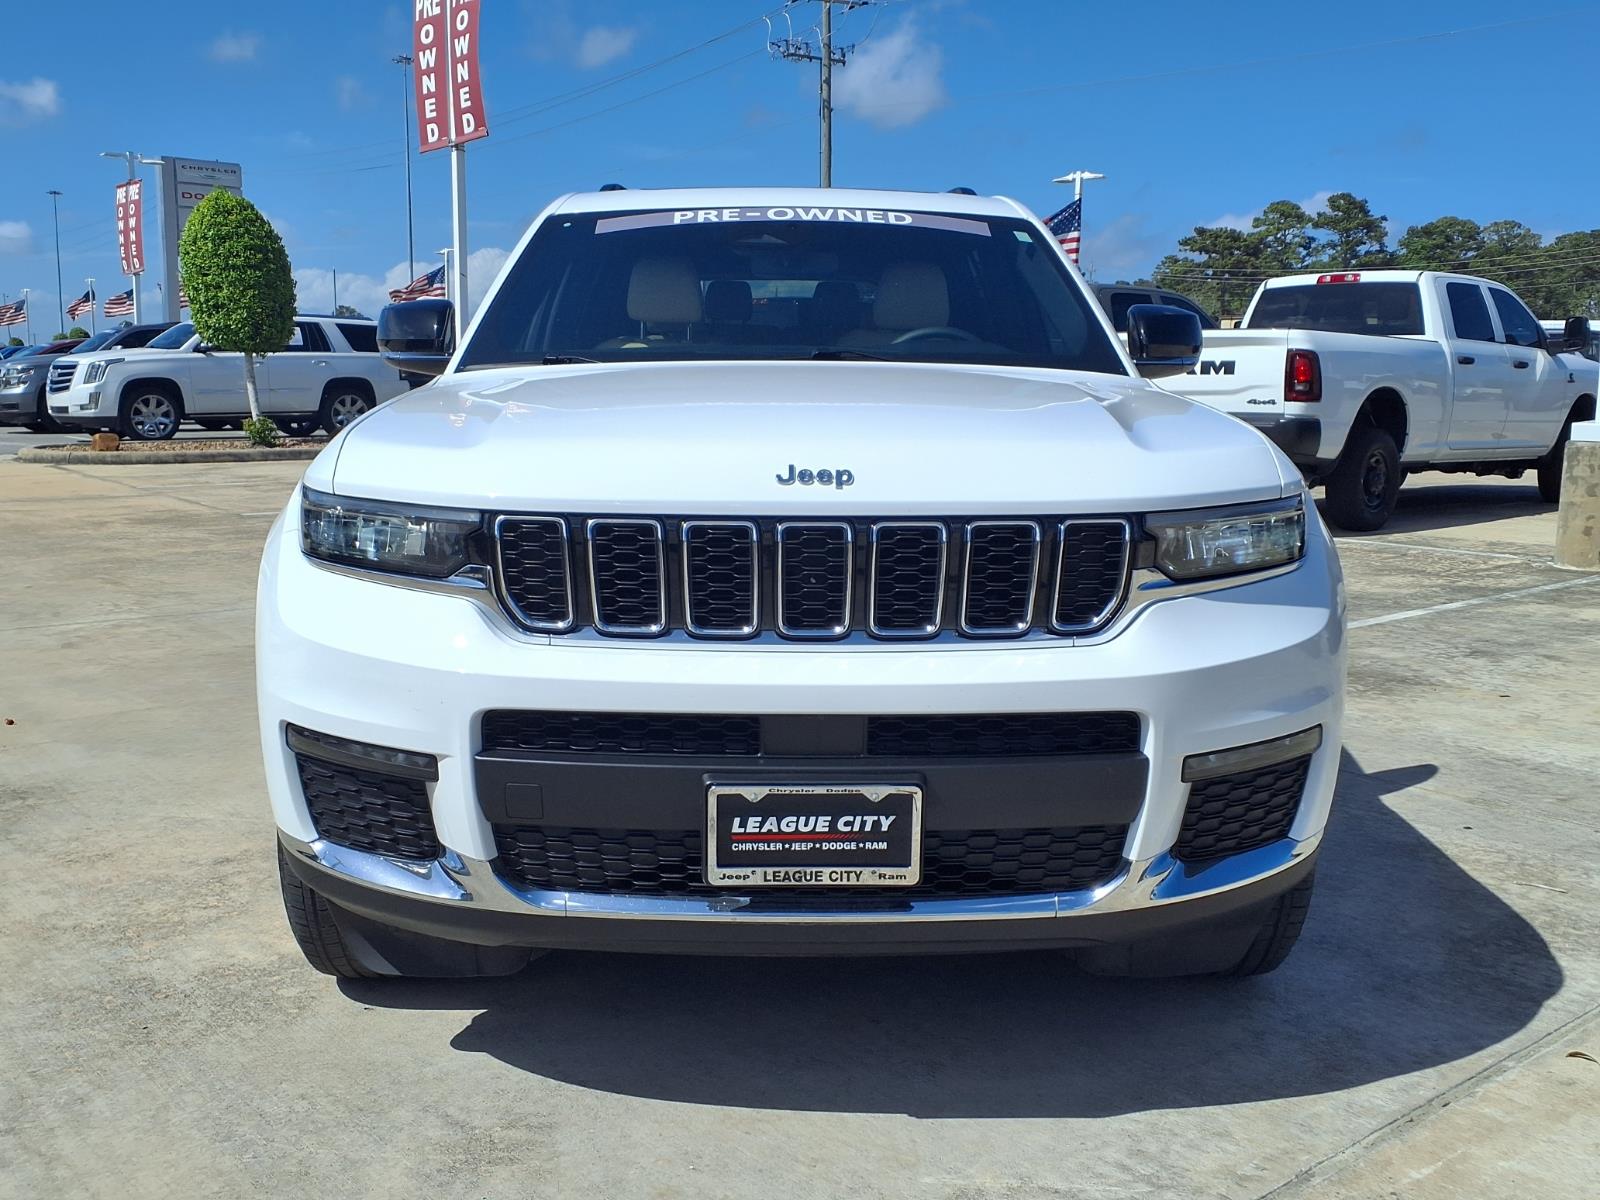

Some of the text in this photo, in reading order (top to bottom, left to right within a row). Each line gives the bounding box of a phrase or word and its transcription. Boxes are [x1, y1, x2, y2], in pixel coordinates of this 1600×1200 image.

[454, 9, 475, 135] OWNED
[418, 23, 439, 143] OWNED
[181, 164, 237, 175] CHRYSLER
[116, 186, 127, 205] PRE
[128, 183, 140, 202] PRE
[673, 207, 913, 225] PRE-OWNED
[118, 206, 128, 271] OWNED
[128, 203, 140, 270] OWNED
[775, 463, 855, 490] Jeep
[731, 815, 896, 833] LEAGUE CITY
[731, 841, 888, 851] CHRYSLER JEEP DODGE RAM
[719, 870, 907, 883] Jeep LEAGUE CITY Ram
